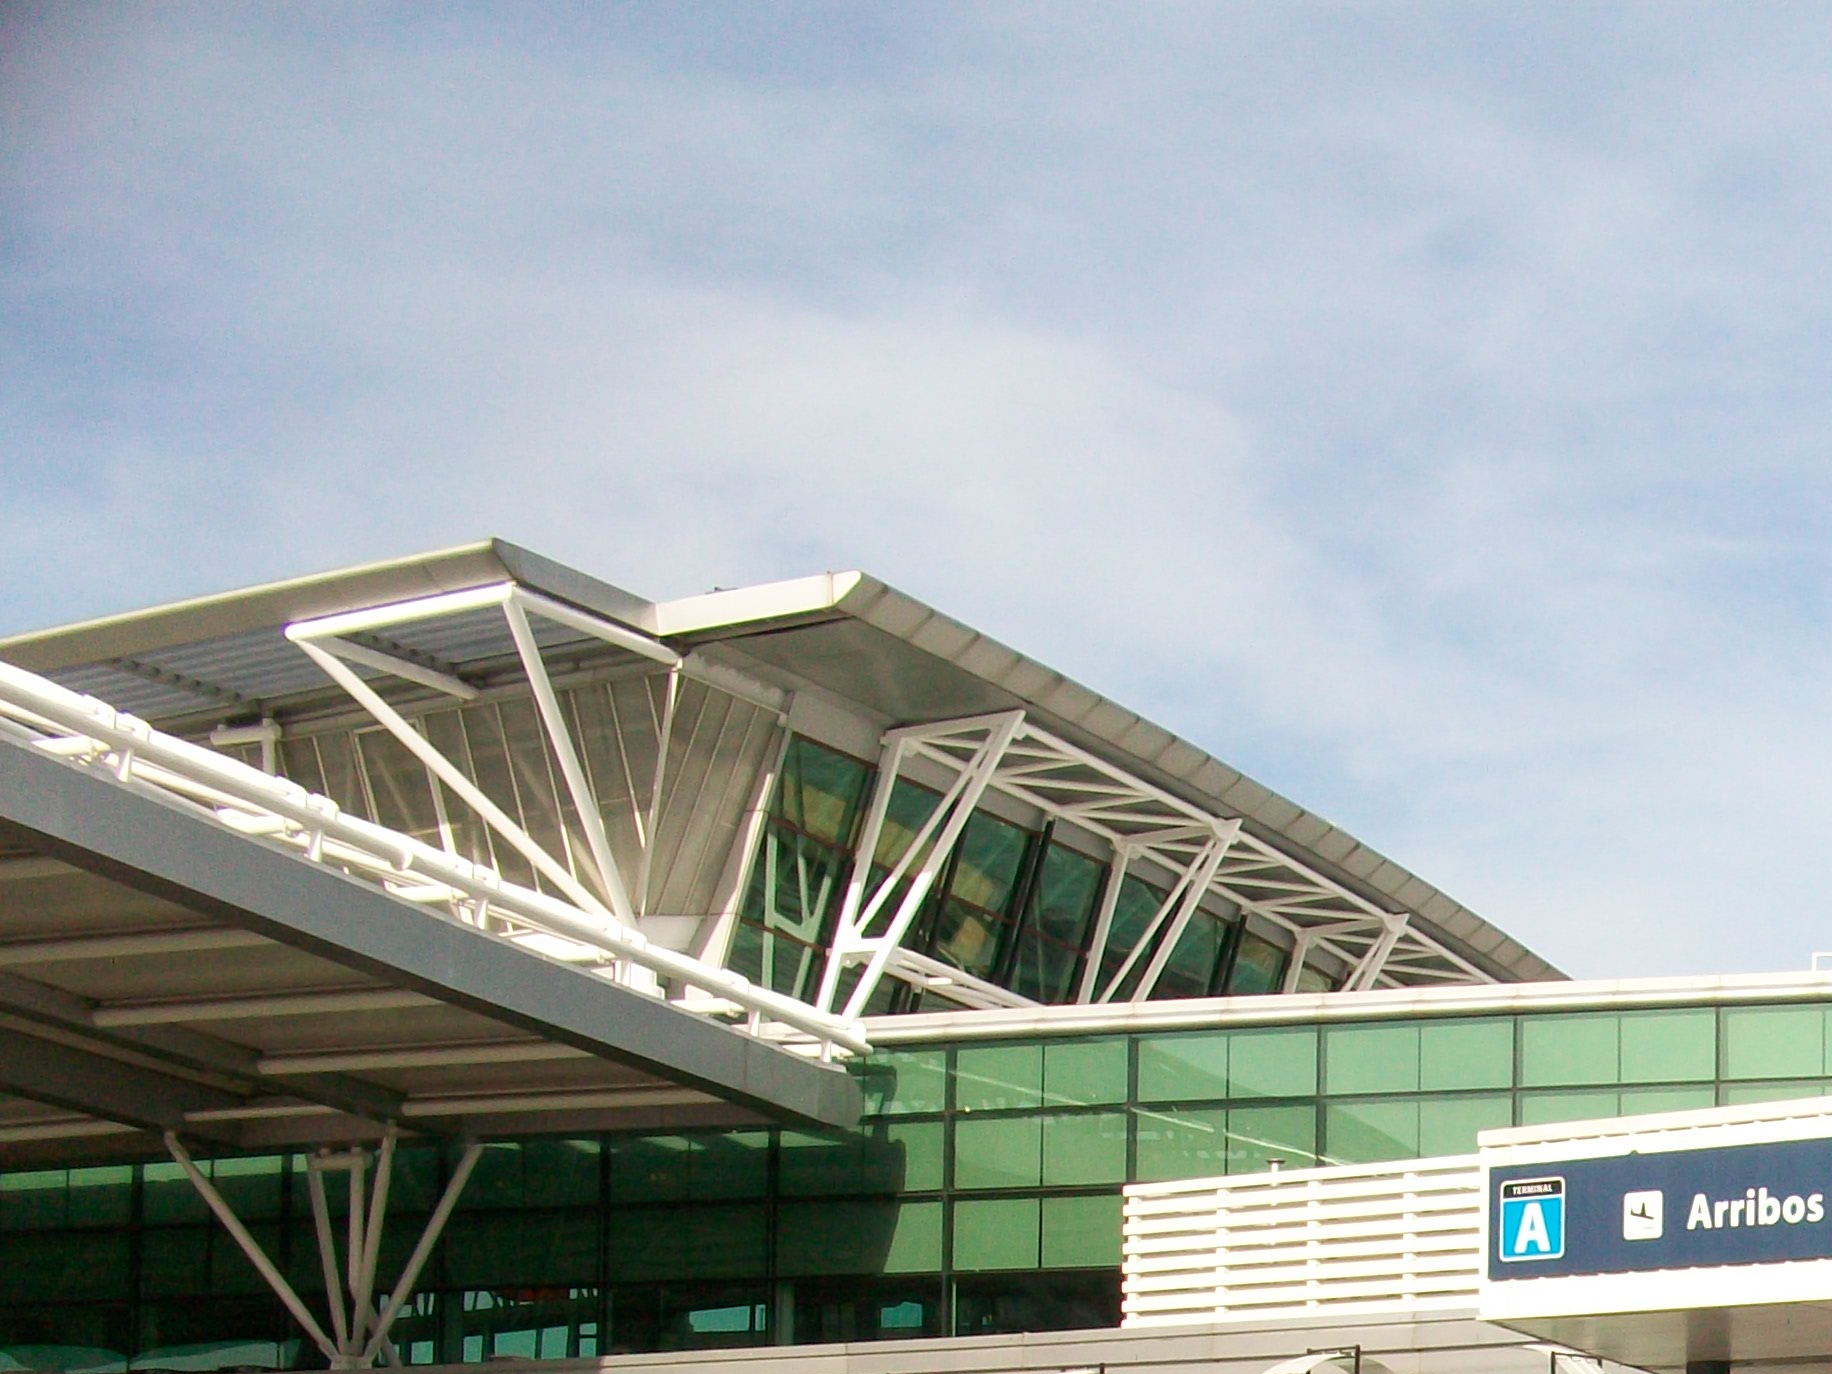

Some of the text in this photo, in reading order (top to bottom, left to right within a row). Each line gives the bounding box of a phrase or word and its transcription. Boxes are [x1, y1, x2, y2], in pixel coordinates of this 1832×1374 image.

[1512, 1184, 1553, 1196] TERMINAL
[1686, 1186, 1825, 1231] Arribos
[1514, 1202, 1551, 1254] A
